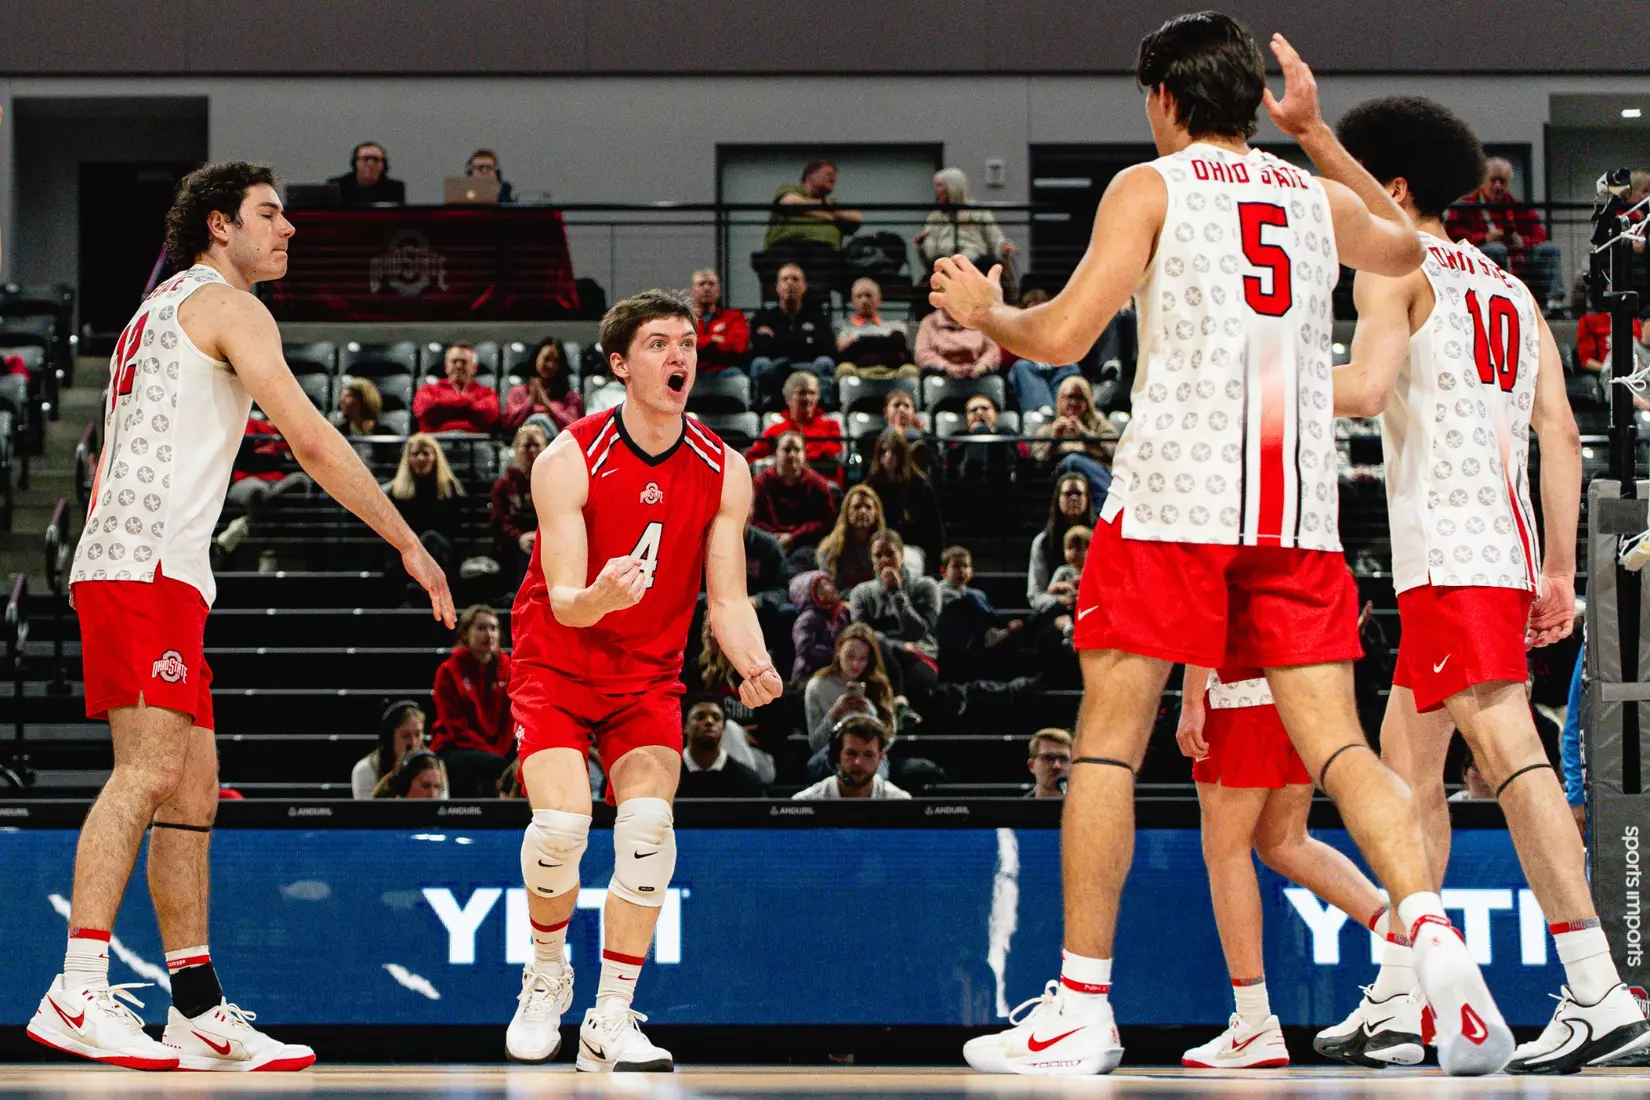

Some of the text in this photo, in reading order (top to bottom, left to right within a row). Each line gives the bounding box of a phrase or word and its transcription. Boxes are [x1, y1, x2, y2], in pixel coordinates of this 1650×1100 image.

[1191, 159, 1250, 183] OHIO
[1237, 201, 1292, 317] 5
[111, 310, 150, 413] 12
[1465, 287, 1520, 393] 10
[629, 521, 664, 590] 4
[421, 887, 682, 964] YEI
[1282, 888, 1548, 965] YTI
[1621, 825, 1644, 968] sports imports
